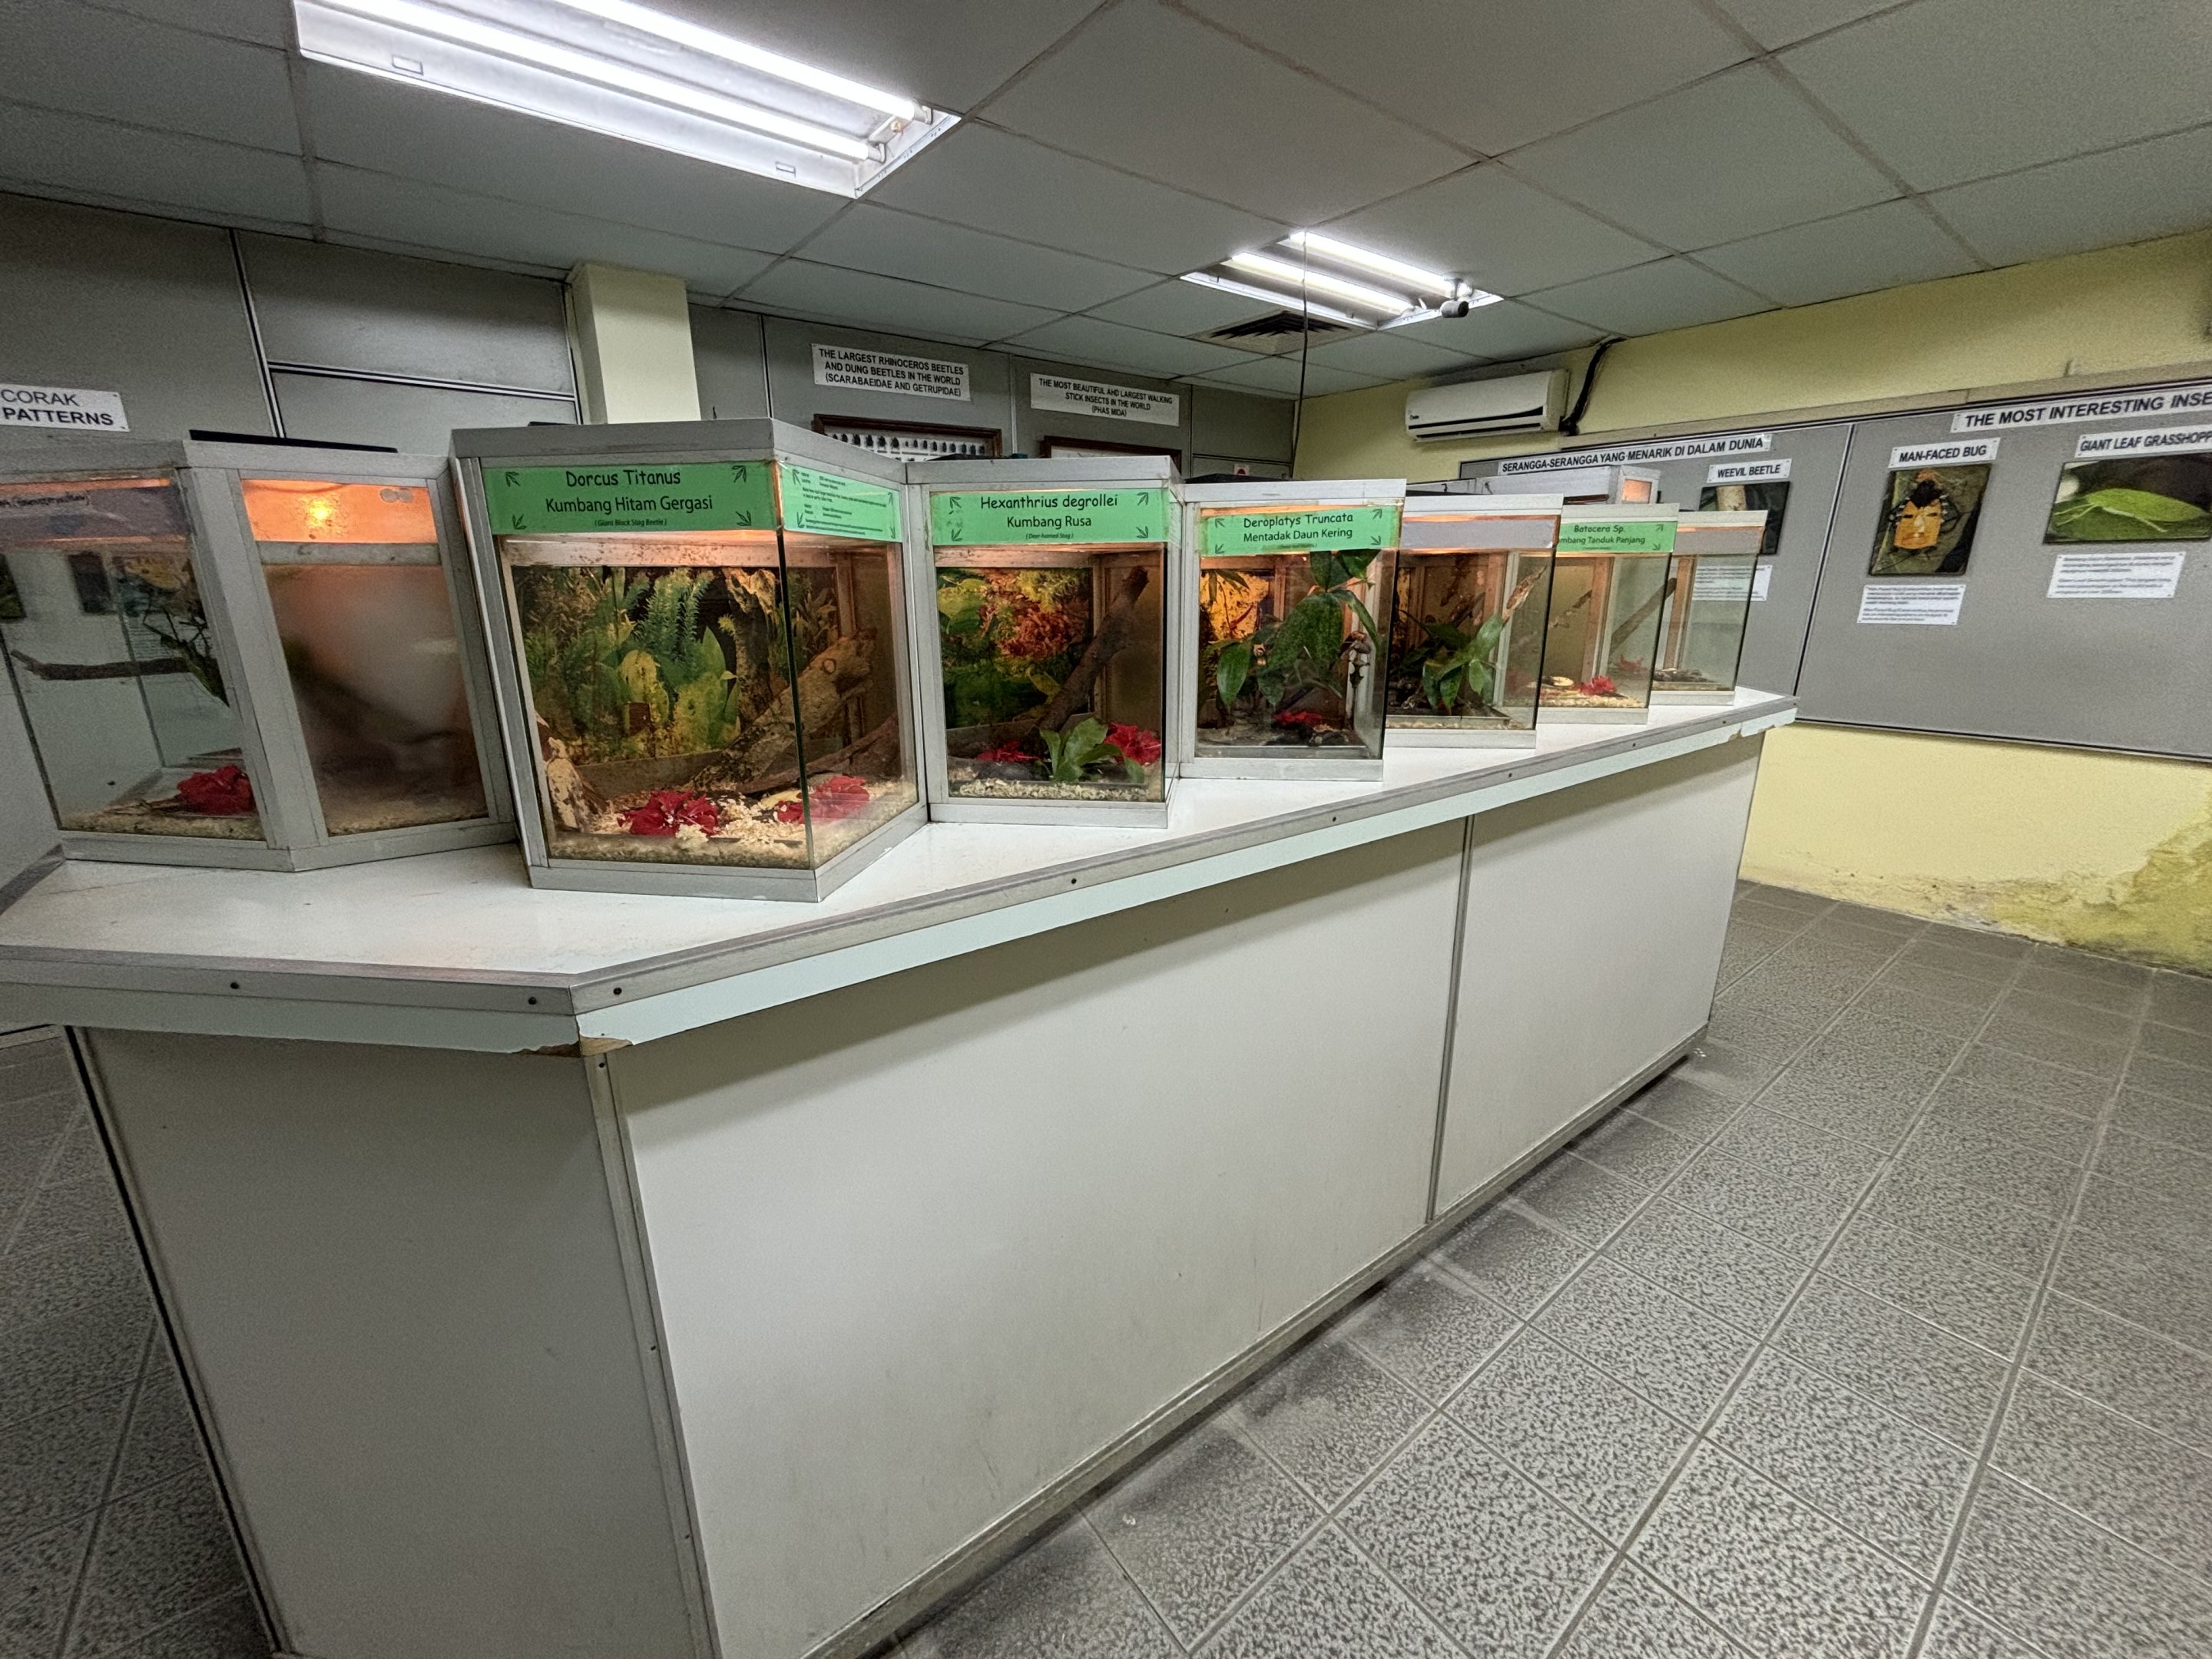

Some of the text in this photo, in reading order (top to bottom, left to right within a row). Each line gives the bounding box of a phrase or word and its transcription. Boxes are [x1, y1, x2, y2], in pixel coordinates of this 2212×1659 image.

[819, 348, 964, 375] THE LARGEST RHINOCEROS BEETLES
[825, 362, 843, 371] AND
[845, 365, 869, 375] DUNG
[870, 367, 906, 379] BEETLES
[917, 373, 932, 382] THE
[933, 375, 960, 386] WORLD
[826, 373, 961, 397] (SCARABAEIDAE AND GETRUPIDAE)
[1039, 378, 1051, 387] THE
[1053, 380, 1071, 390] MOST
[1073, 382, 1105, 395] BEAUTIFUL
[1121, 389, 1147, 400] LARGEST
[1147, 394, 1173, 404] WALKING
[1, 389, 80, 406] CORAK
[1065, 392, 1084, 402] STICK
[1085, 396, 1109, 406] INSECTS
[1118, 399, 1129, 409] THE
[1130, 401, 1151, 410] WORLD
[2, 407, 114, 426] PATTERNS
[1965, 391, 2212, 427] THE MOST INTERESTING INSE
[2080, 431, 2212, 452] GIANT LEAF GRASSHOPP
[1502, 437, 1763, 472] SERANGGA-SERANGGA YANG MENARIK DI DALAM DUNIA
[1899, 445, 1987, 462] MAN-FACED BUG
[565, 469, 680, 487] Dorcus Titanus
[1717, 464, 1781, 478] WEEVIL BEETLE
[545, 495, 713, 515] Kumbang Hitam Gergasi
[981, 494, 1118, 511] Hexanthrius degrollei
[1007, 515, 1091, 530] Kumbang Rusa
[1243, 514, 1353, 529] Deroplatys Truncata
[1575, 525, 1610, 533] Batocera
[1243, 528, 1353, 542] Mentadak Daun Kering
[1560, 536, 1645, 545] mbang Tanduk Panjang
